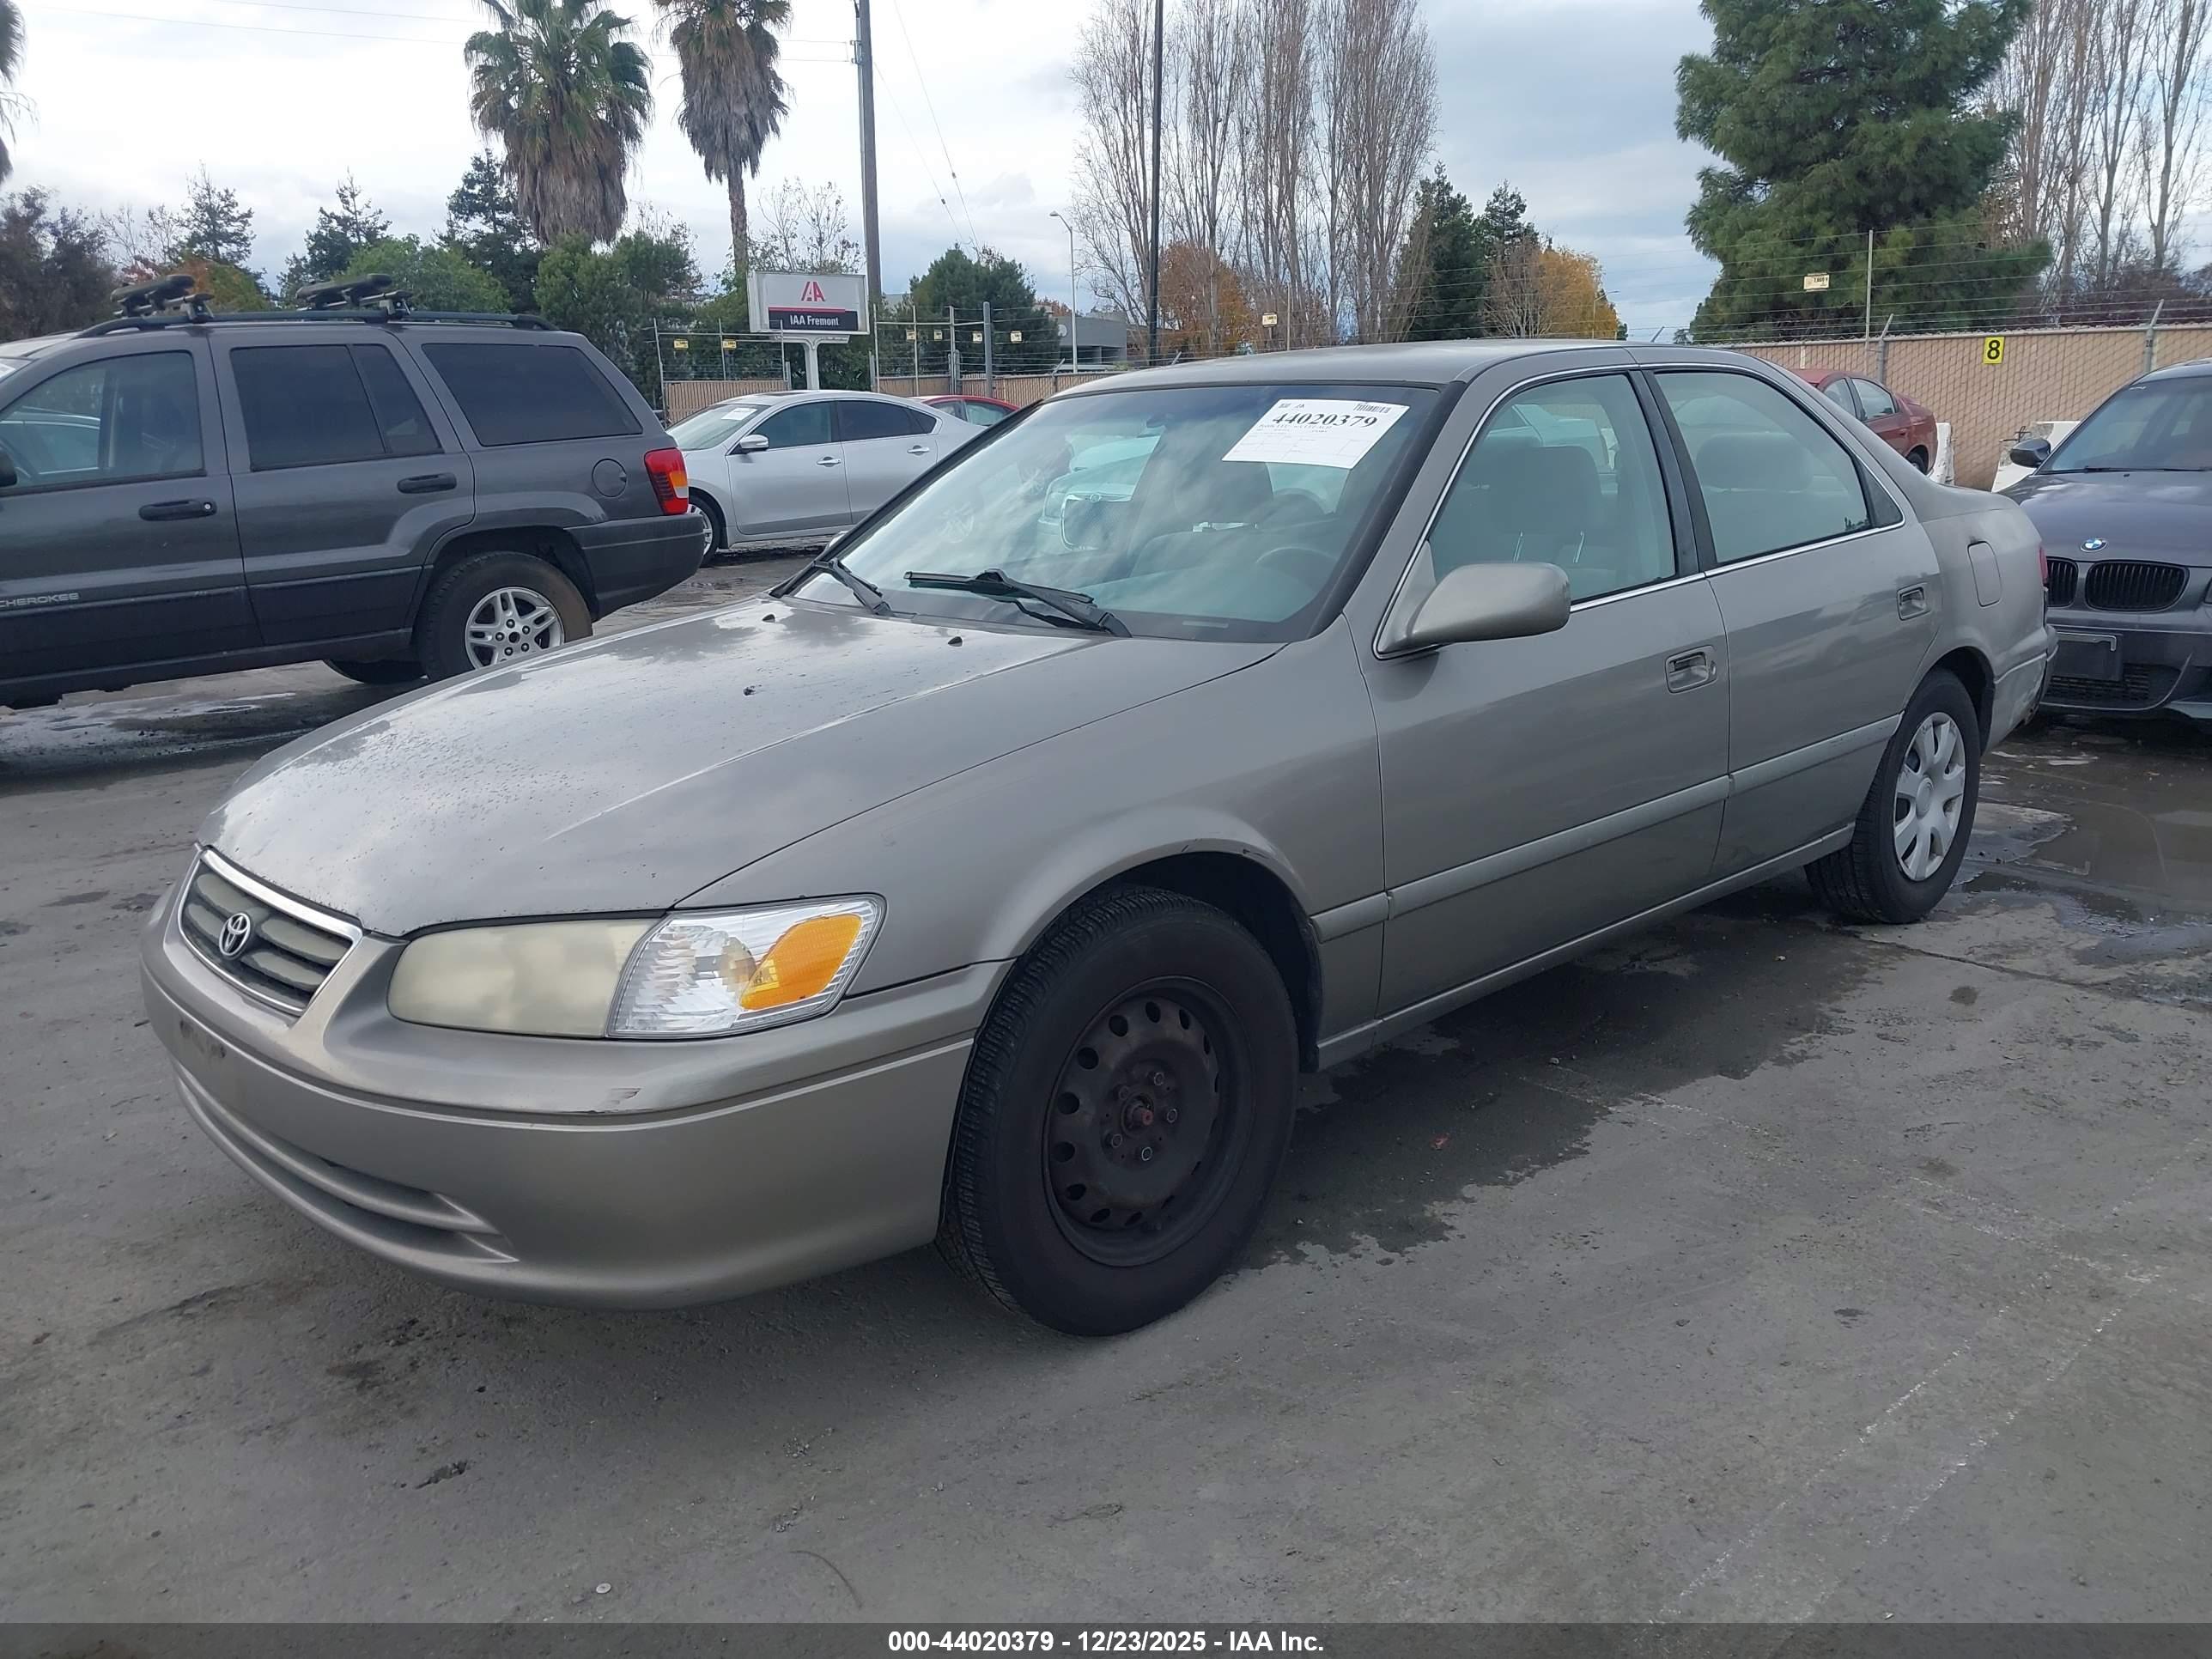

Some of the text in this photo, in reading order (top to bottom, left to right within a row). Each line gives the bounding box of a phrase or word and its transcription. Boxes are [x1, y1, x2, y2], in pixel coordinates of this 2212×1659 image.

[790, 315, 839, 325] IAA Fremont
[1987, 339, 2000, 360] 8
[1273, 412, 1378, 428] 44020379
